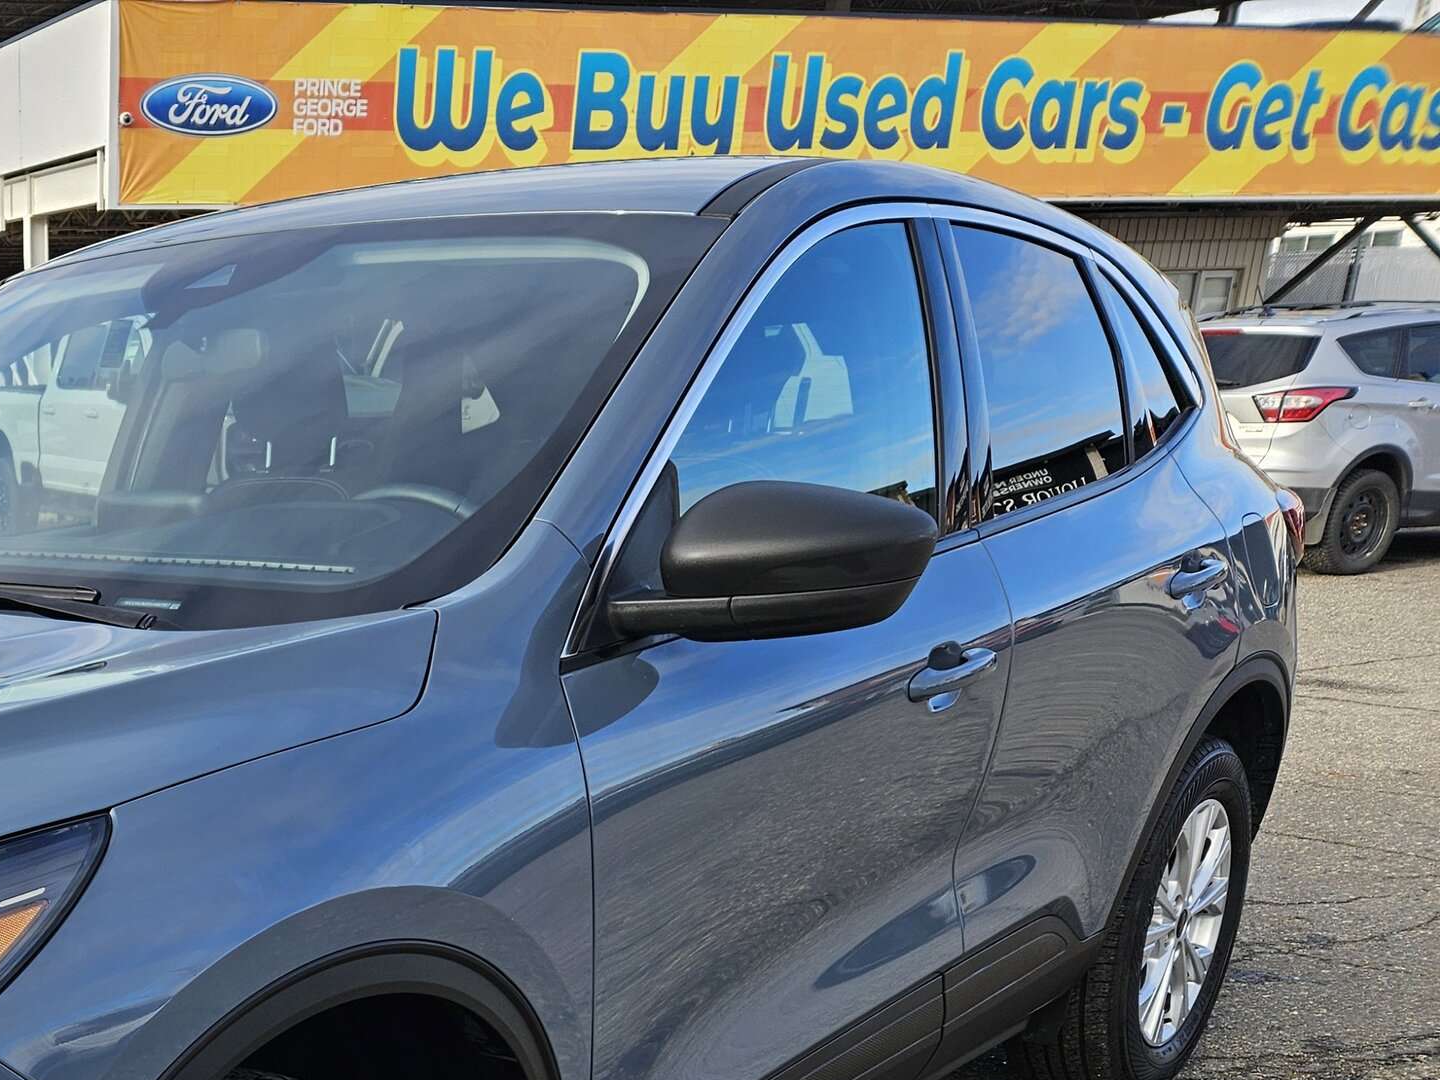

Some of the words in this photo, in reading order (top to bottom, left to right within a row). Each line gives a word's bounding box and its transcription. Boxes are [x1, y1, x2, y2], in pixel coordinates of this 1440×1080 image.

[294, 79, 361, 97] PRINCE
[168, 83, 253, 126] Ford
[293, 99, 368, 117] GEORGE
[395, 47, 546, 152] We
[572, 50, 741, 155] Buy
[765, 51, 965, 151] Used
[980, 56, 1143, 151] Cars
[1205, 60, 1322, 152] Get
[293, 119, 343, 136] FORD
